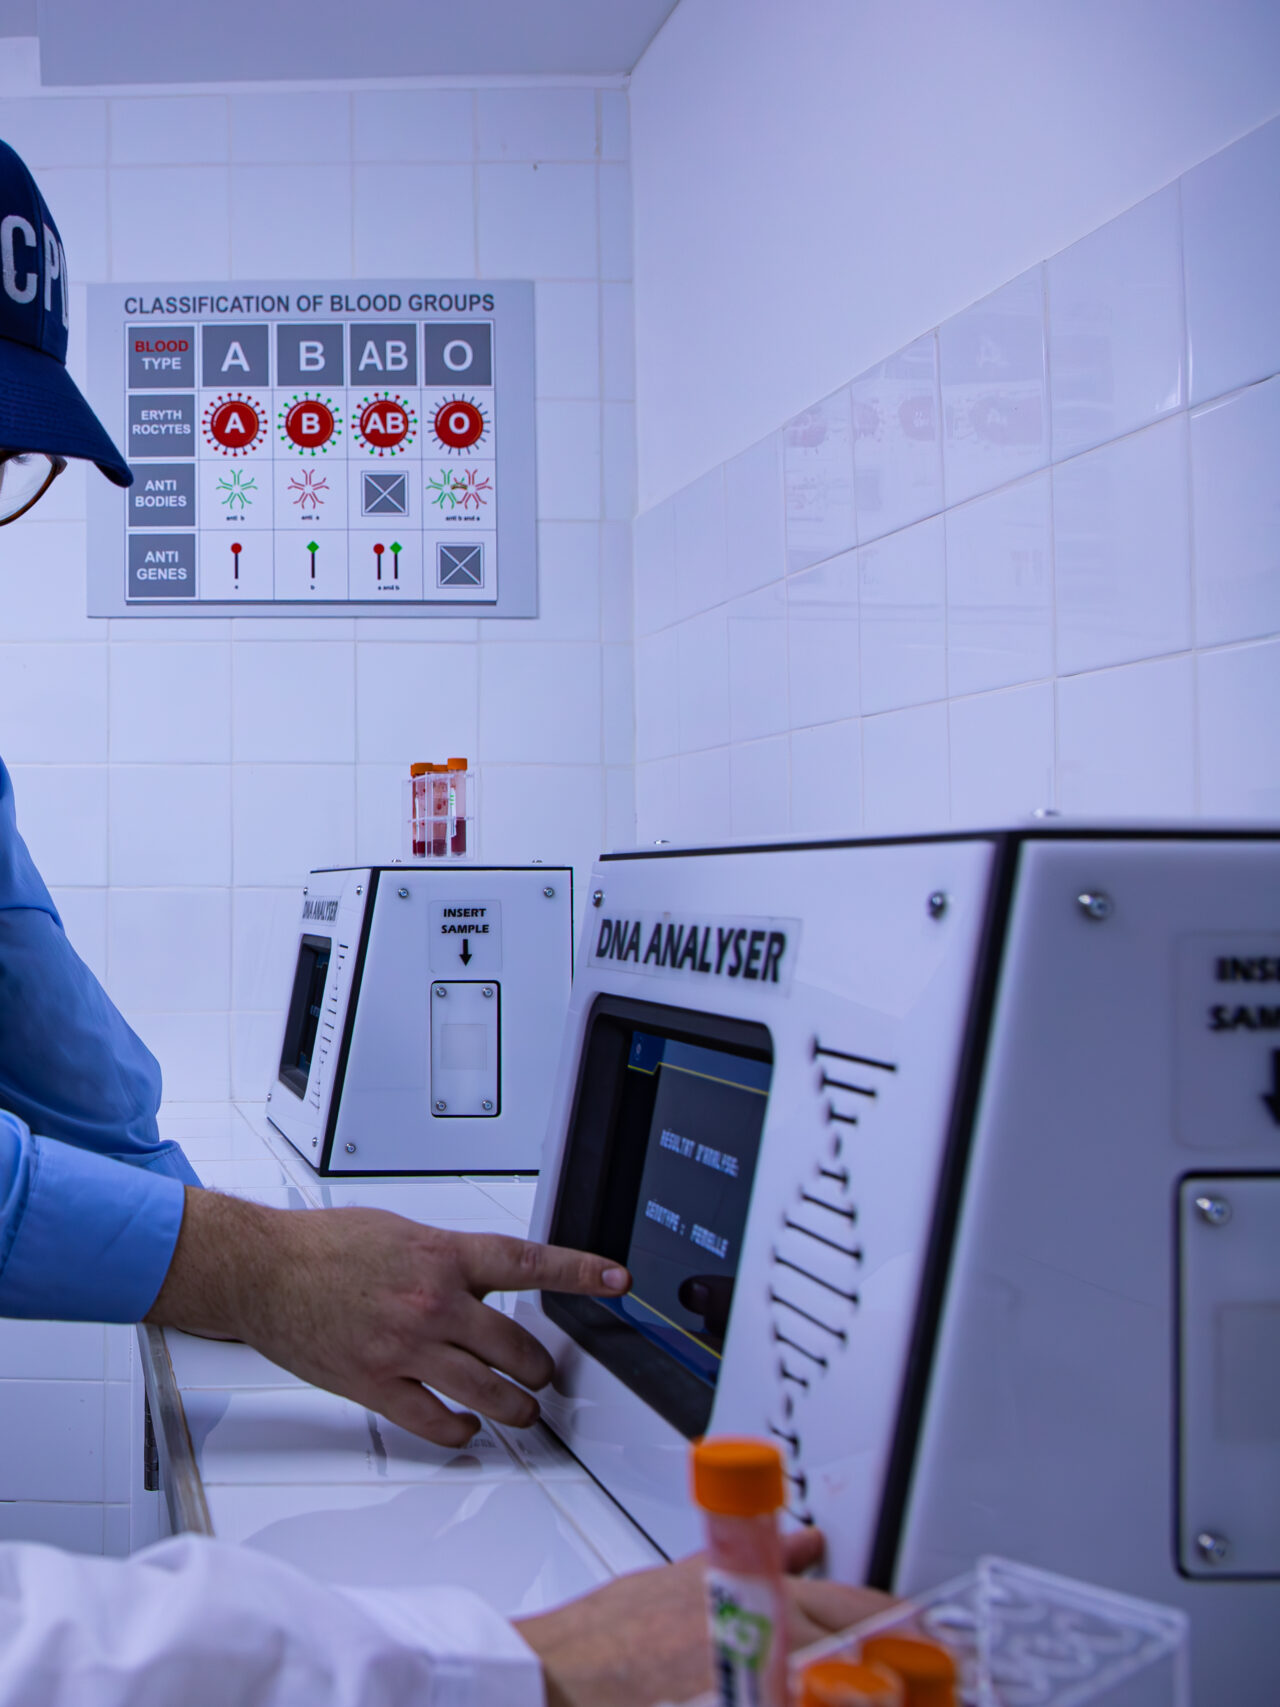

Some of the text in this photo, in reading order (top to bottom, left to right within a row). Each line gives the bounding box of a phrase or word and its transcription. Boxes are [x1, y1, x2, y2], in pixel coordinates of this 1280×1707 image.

[124, 294, 495, 314] CLASSIFICATION OF BLOOD GROUPS
[135, 340, 189, 352] BLOOD
[299, 340, 326, 372] B
[358, 340, 409, 372] AB
[443, 339, 474, 372] O
[141, 357, 182, 370] TYPE
[221, 341, 250, 372] A
[140, 410, 183, 421] ERYTH
[224, 412, 246, 434] A
[301, 412, 321, 434] B
[365, 412, 405, 434] AB
[449, 412, 471, 435] O
[132, 424, 192, 435] ROCYTES
[144, 480, 177, 491] ANTI
[135, 496, 187, 507] BODIES
[144, 551, 179, 563] ANTI
[136, 568, 188, 580] GENES
[443, 908, 487, 918] INSERT
[441, 924, 489, 934] SAMPLE
[596, 918, 786, 983] DNA ANALYSER
[1216, 956, 1280, 982] INS
